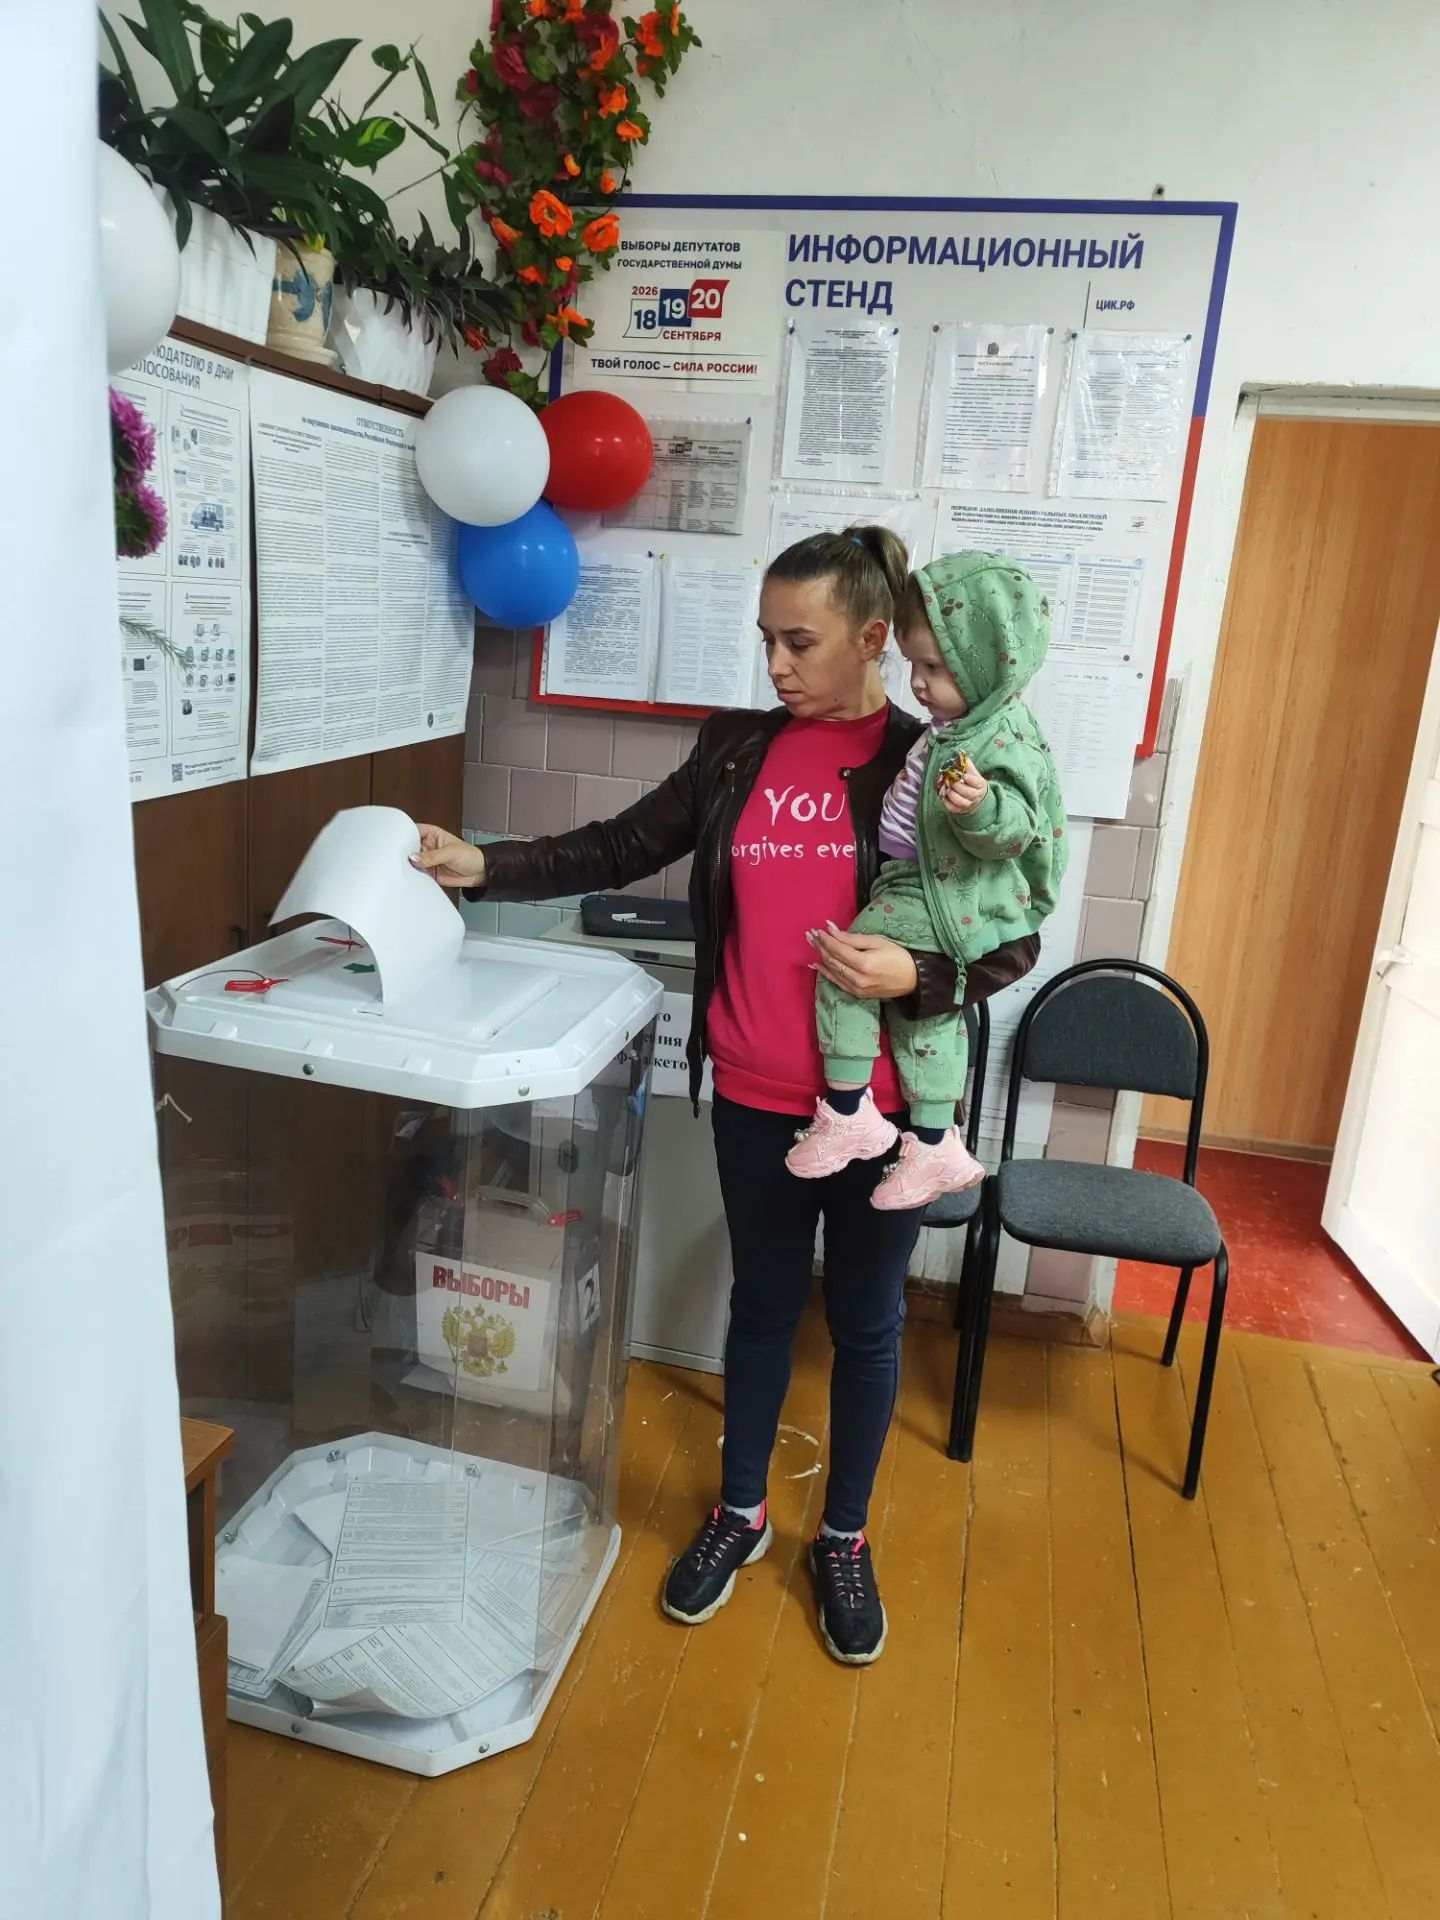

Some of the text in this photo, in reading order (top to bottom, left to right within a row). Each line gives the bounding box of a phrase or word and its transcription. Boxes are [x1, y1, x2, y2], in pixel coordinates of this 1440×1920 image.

[621, 241, 740, 252] ВЫБОРЫ ДЕПУТАТОВ
[788, 232, 1144, 272] ИНФОРМАЦИОННЫЙ
[617, 258, 742, 270] ГОСУДАРСТВЕННОЙ ДУМЫ
[632, 286, 658, 296] 2026
[691, 288, 721, 309] 20
[785, 278, 893, 315] СТЕНД
[662, 298, 686, 319] 19
[1095, 299, 1136, 311] ЦИК.РФ
[633, 309, 657, 330] 18
[662, 330, 722, 341] СЕНТЯБРЯ
[152, 344, 234, 380] ЮДАТЕЛЮ В ДНИ
[591, 358, 620, 369] ТВОЙ
[624, 359, 660, 370] ГОЛОС
[673, 362, 703, 372] СИЛА
[706, 363, 757, 374] РОССИИ!
[764, 785, 846, 826] YOU
[432, 1265, 531, 1309] ВЫБОРЫ
